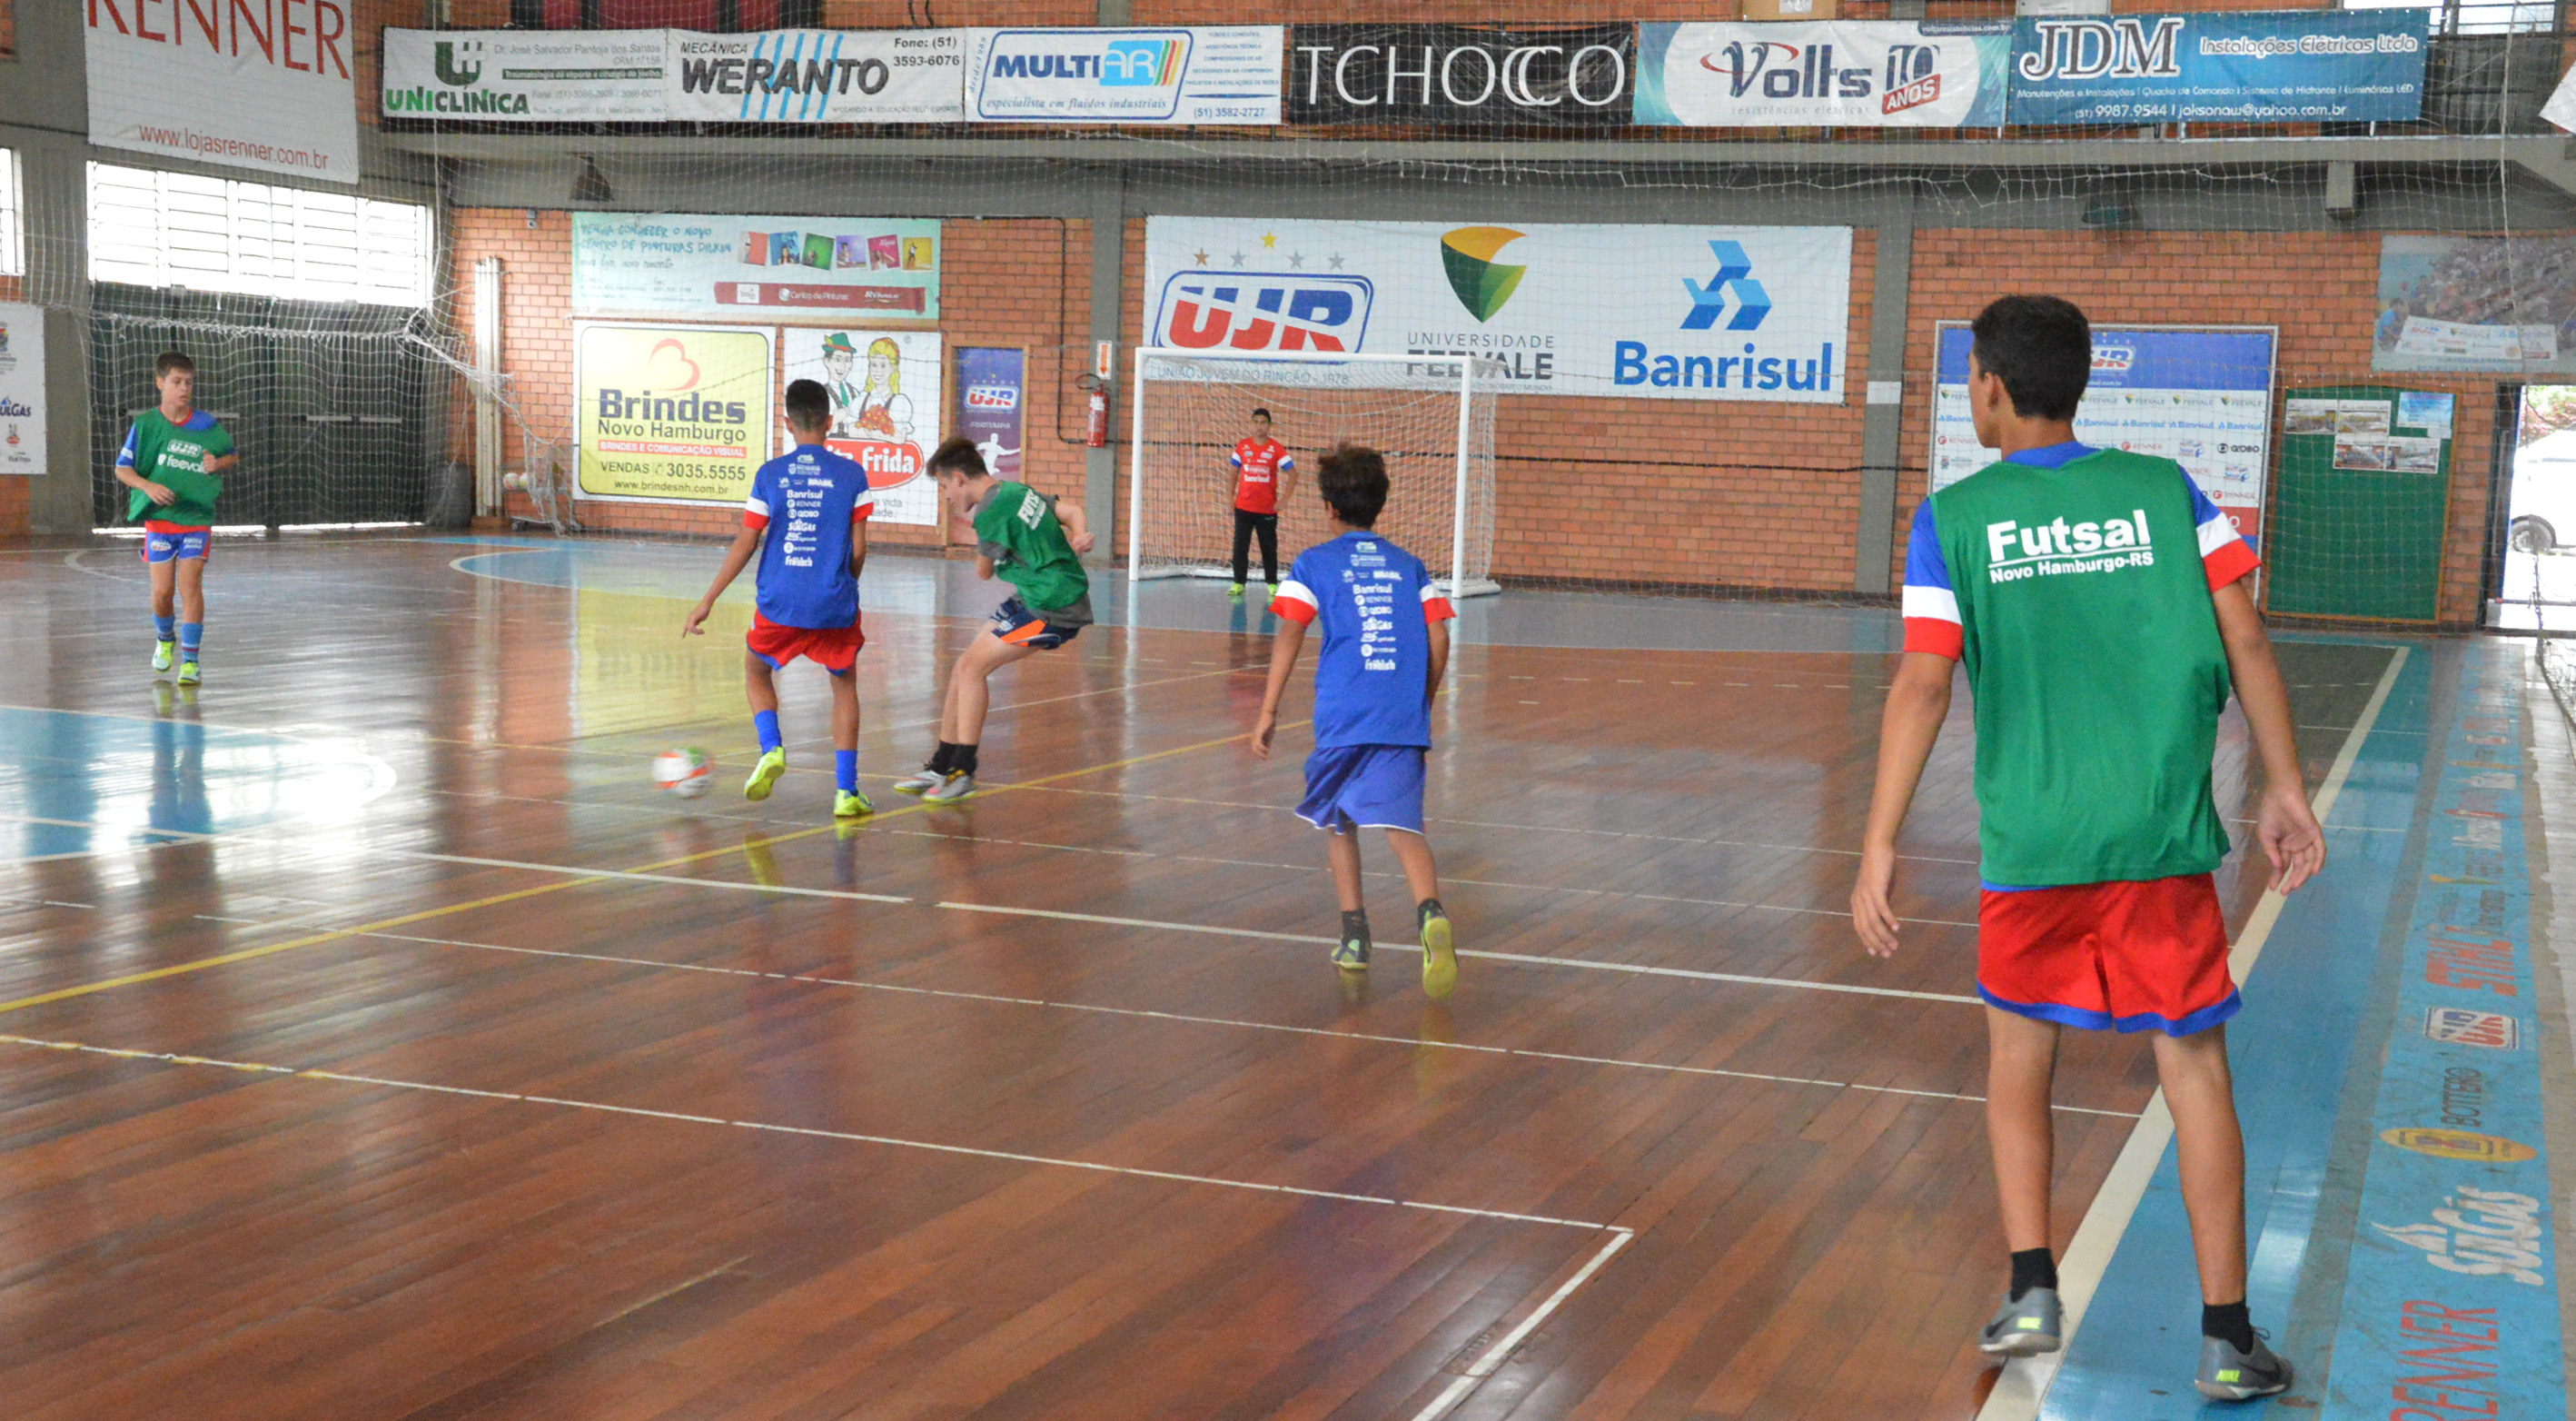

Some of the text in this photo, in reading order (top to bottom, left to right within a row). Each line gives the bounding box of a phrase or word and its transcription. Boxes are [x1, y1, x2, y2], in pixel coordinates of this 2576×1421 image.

[680, 41, 748, 55] MECÂNICA
[894, 37, 957, 49] Fone: (51)
[2019, 16, 2185, 82] JDM
[2200, 33, 2418, 59] Instalações Elétricas Ltda
[893, 55, 960, 66] 3593-6076
[1722, 40, 1872, 98] Volts
[1888, 45, 1940, 90] 10
[681, 58, 889, 94] WERANTO
[1297, 45, 1625, 106] TCHOCCO
[1887, 77, 1937, 111] ANOS
[2016, 89, 2076, 99] Manutenções
[2086, 88, 2135, 98] Instalações
[2193, 85, 2234, 95] Comando
[2281, 85, 2294, 94] de
[2296, 85, 2336, 94] Hidrante
[2343, 84, 2393, 94] Luminárias
[2396, 84, 2414, 93] LED
[986, 96, 1167, 110] especialista em fluidos industriais
[1194, 107, 1265, 118] (51) 3582-2727
[1731, 104, 1870, 115] resistências elétricas
[2095, 104, 2167, 118] 9987.9544
[139, 124, 328, 171] www.lojasrenner.com.br
[640, 240, 694, 254] PINTURAS
[789, 290, 811, 301] Centro
[1169, 284, 1353, 353] UJR
[1408, 333, 1554, 349] UNIVERSIDADE
[1614, 341, 1832, 392] Banrisul
[2091, 349, 2129, 368] JR
[599, 388, 746, 424] Brindes
[969, 389, 1014, 406] UJR
[1947, 414, 1973, 422] Banris
[2131, 420, 2166, 428] Banrisul
[2178, 421, 2214, 429] Banrisul
[2227, 422, 2263, 430] Banrisul
[598, 419, 747, 445] Novo Hamburgo
[599, 441, 745, 457] BRINDES E COMUNICAÇÃO VISUAL
[2231, 444, 2260, 453] GLOBO
[862, 446, 915, 474] Frida
[600, 461, 747, 481] VENDAS 3035.5555
[614, 480, 729, 495] www.brindesnh.com.br
[787, 489, 823, 500] Banrisul
[1986, 509, 2151, 563] Futsal
[1990, 551, 2155, 584] Novo Hamburgo-RS
[1352, 583, 1393, 594] Banrisul
[2425, 937, 2518, 997] STIHL
[2442, 1010, 2505, 1047] UJR
[2440, 1067, 2483, 1128] BOTTERO
